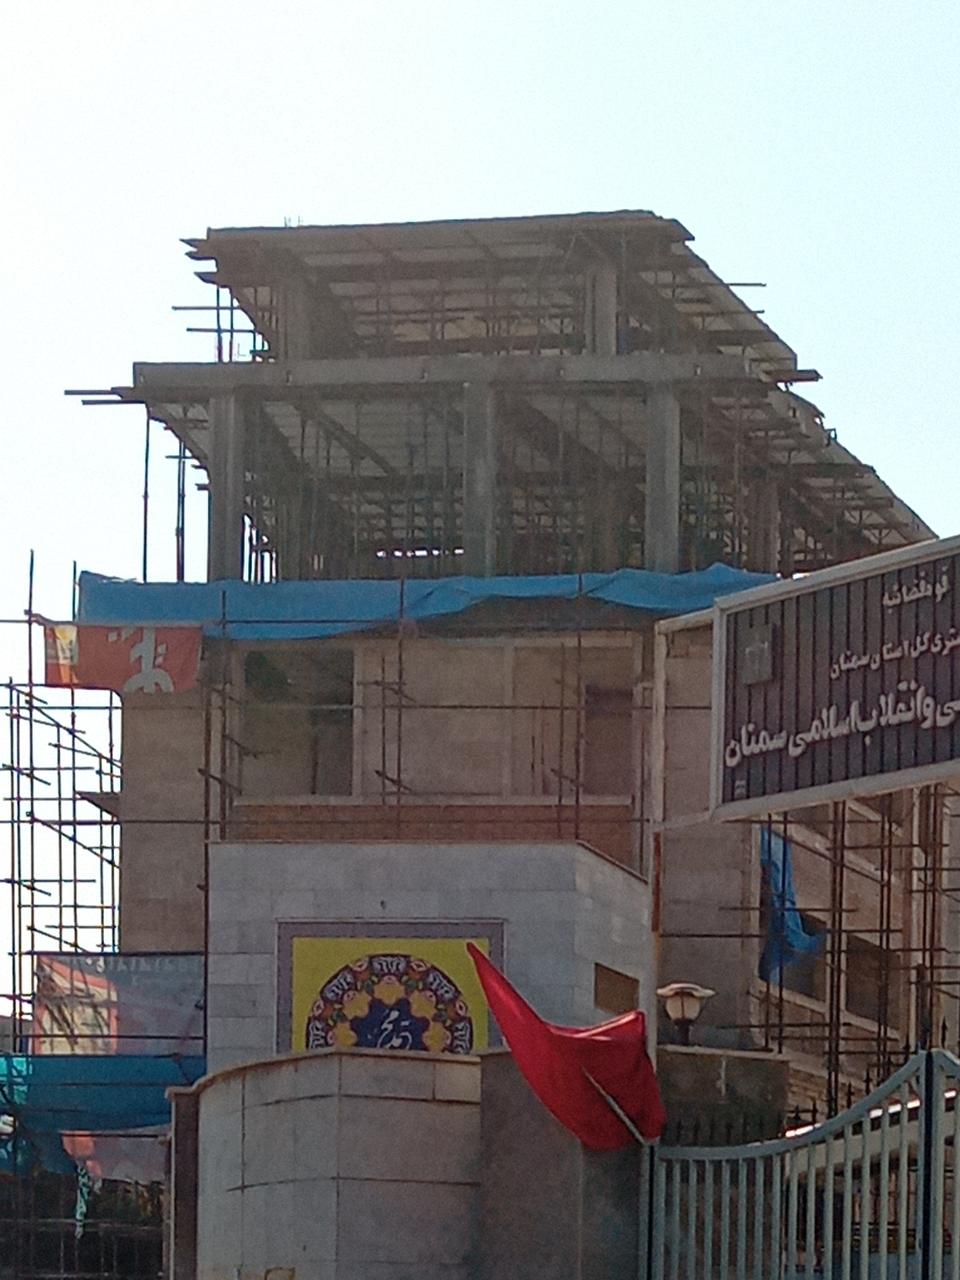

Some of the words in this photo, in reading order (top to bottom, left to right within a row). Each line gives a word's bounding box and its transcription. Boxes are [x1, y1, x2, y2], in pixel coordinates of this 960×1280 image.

[830, 650, 871, 680] سمنان
[870, 640, 909, 671] استان
[725, 722, 788, 768] سمنان
[788, 700, 859, 758] اسلامی
